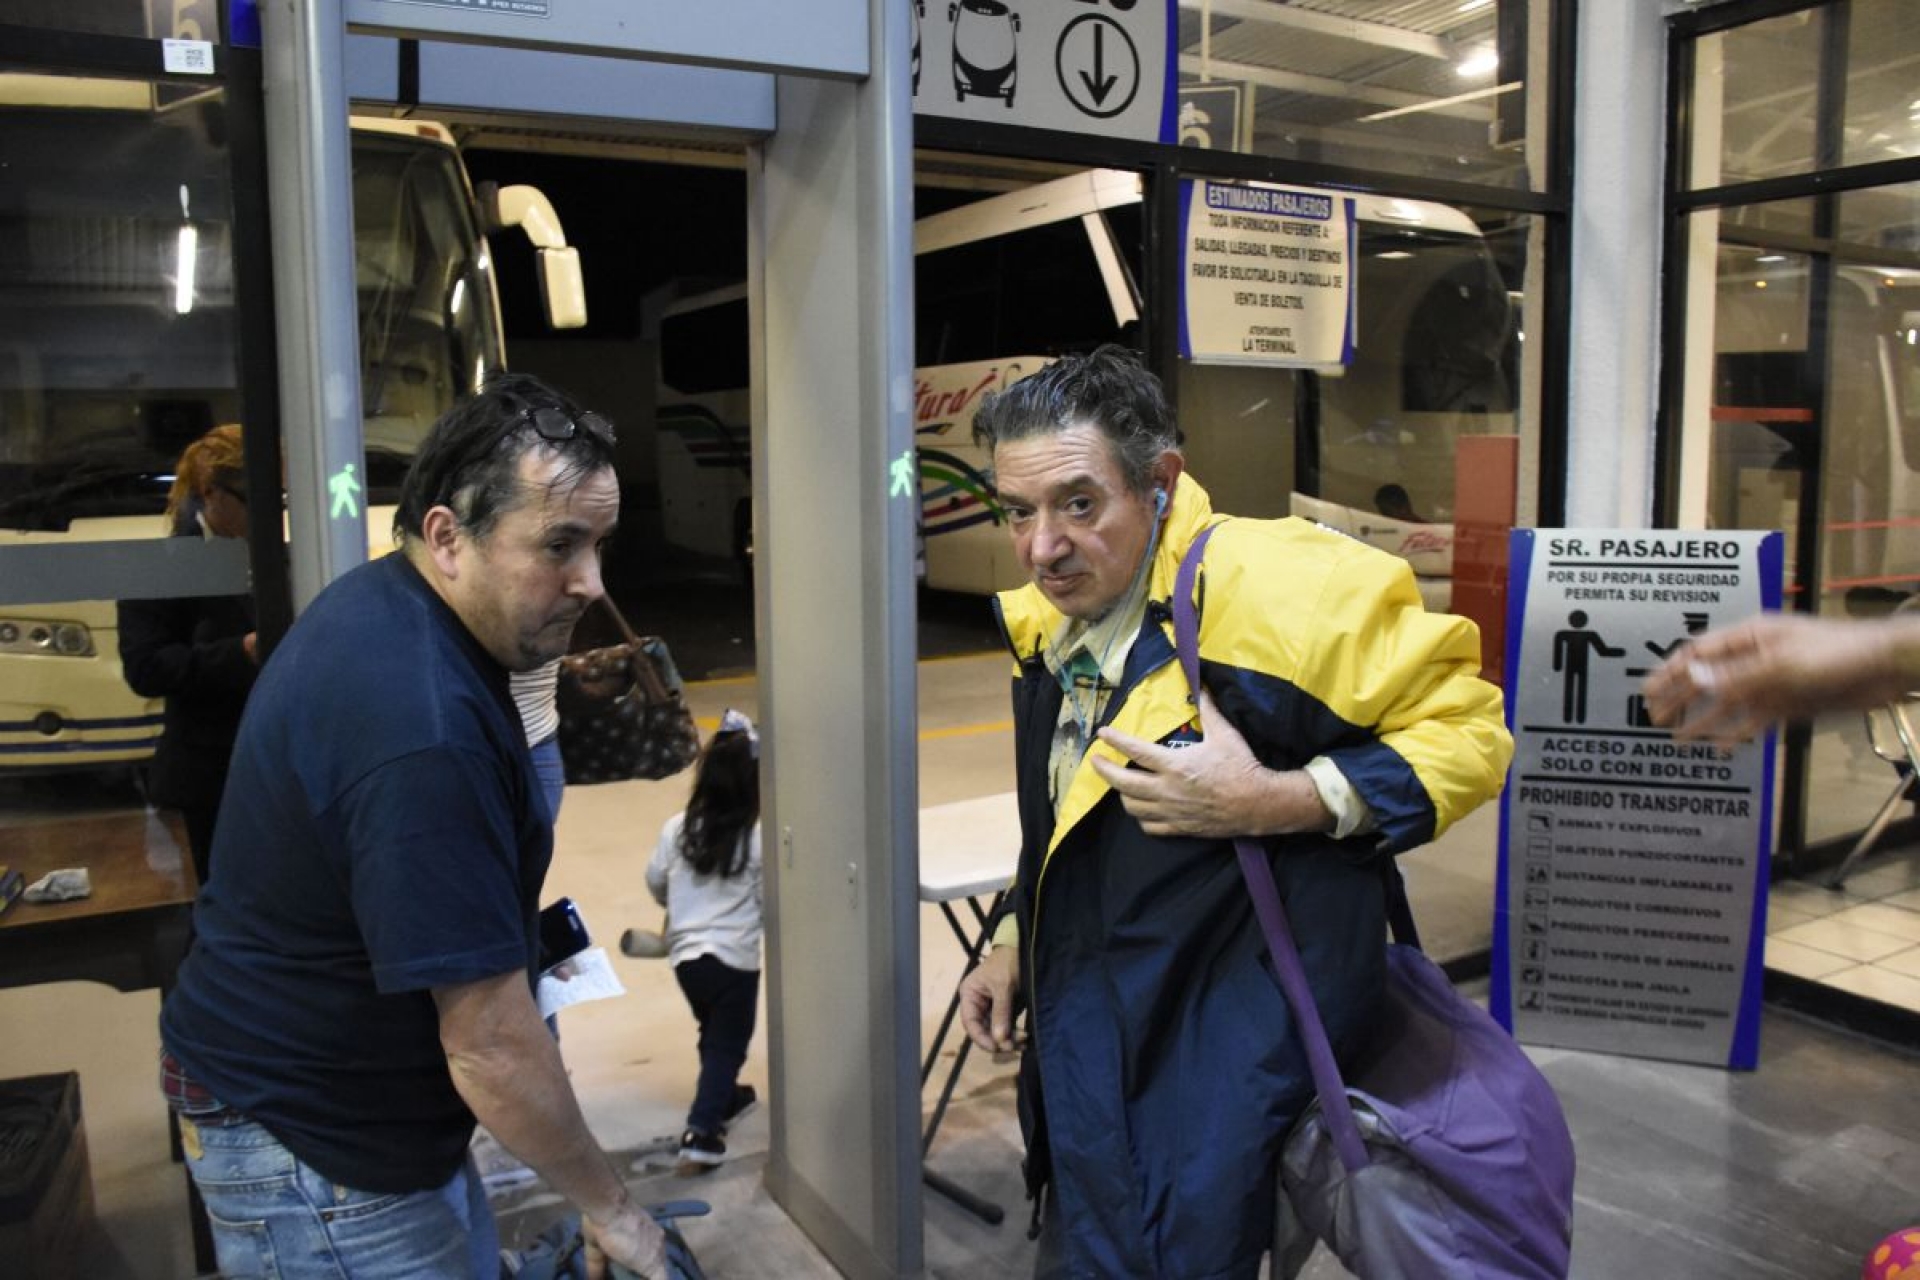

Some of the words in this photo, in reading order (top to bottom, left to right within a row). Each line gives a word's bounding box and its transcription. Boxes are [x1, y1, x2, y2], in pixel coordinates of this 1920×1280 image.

[1209, 185, 1270, 211] ESTIMADOS
[1272, 192, 1330, 219] PASAJEROS
[1192, 263, 1217, 278] FAVOR
[1219, 263, 1228, 279] DE
[1234, 291, 1257, 306] VENTA
[1260, 294, 1269, 307] DE
[1242, 338, 1253, 352] LA
[1255, 339, 1296, 354] TERMINAL
[1549, 539, 1590, 557] SR.
[1599, 540, 1740, 559] PASAJERO
[1547, 571, 1575, 583] POR
[1579, 571, 1597, 584] SU
[1602, 572, 1652, 585] PROPIA
[1657, 572, 1740, 587] SEGURIDAD
[1565, 588, 1625, 601] PERMITA
[1629, 589, 1648, 601] SU
[1653, 590, 1720, 603] REVISION
[1543, 738, 1625, 755] ACCESO
[1631, 741, 1733, 760] ANDENES
[1541, 757, 1594, 773] SOLO
[1601, 759, 1643, 776] CON
[1650, 761, 1732, 780] BOLETO
[1519, 786, 1613, 809] PROHIBIDO
[1619, 792, 1750, 818] TRANSPORTAR
[1557, 818, 1602, 831] ARMAS
[1607, 820, 1615, 831] Y
[1619, 822, 1702, 838] EXPLOSIVOS
[1555, 843, 1615, 858] OBJETOS
[1618, 849, 1746, 867] PUNZOCORTANTES
[1555, 870, 1636, 886] SUSTANCIAS
[1640, 877, 1734, 893] INFLAMABLES
[1552, 896, 1632, 912] PRODUCTOS
[1551, 920, 1629, 936] PRODUCTOS
[1633, 927, 1731, 945] PERECEDEROS
[1644, 955, 1661, 966] DE
[1665, 957, 1735, 973] ANIMALES
